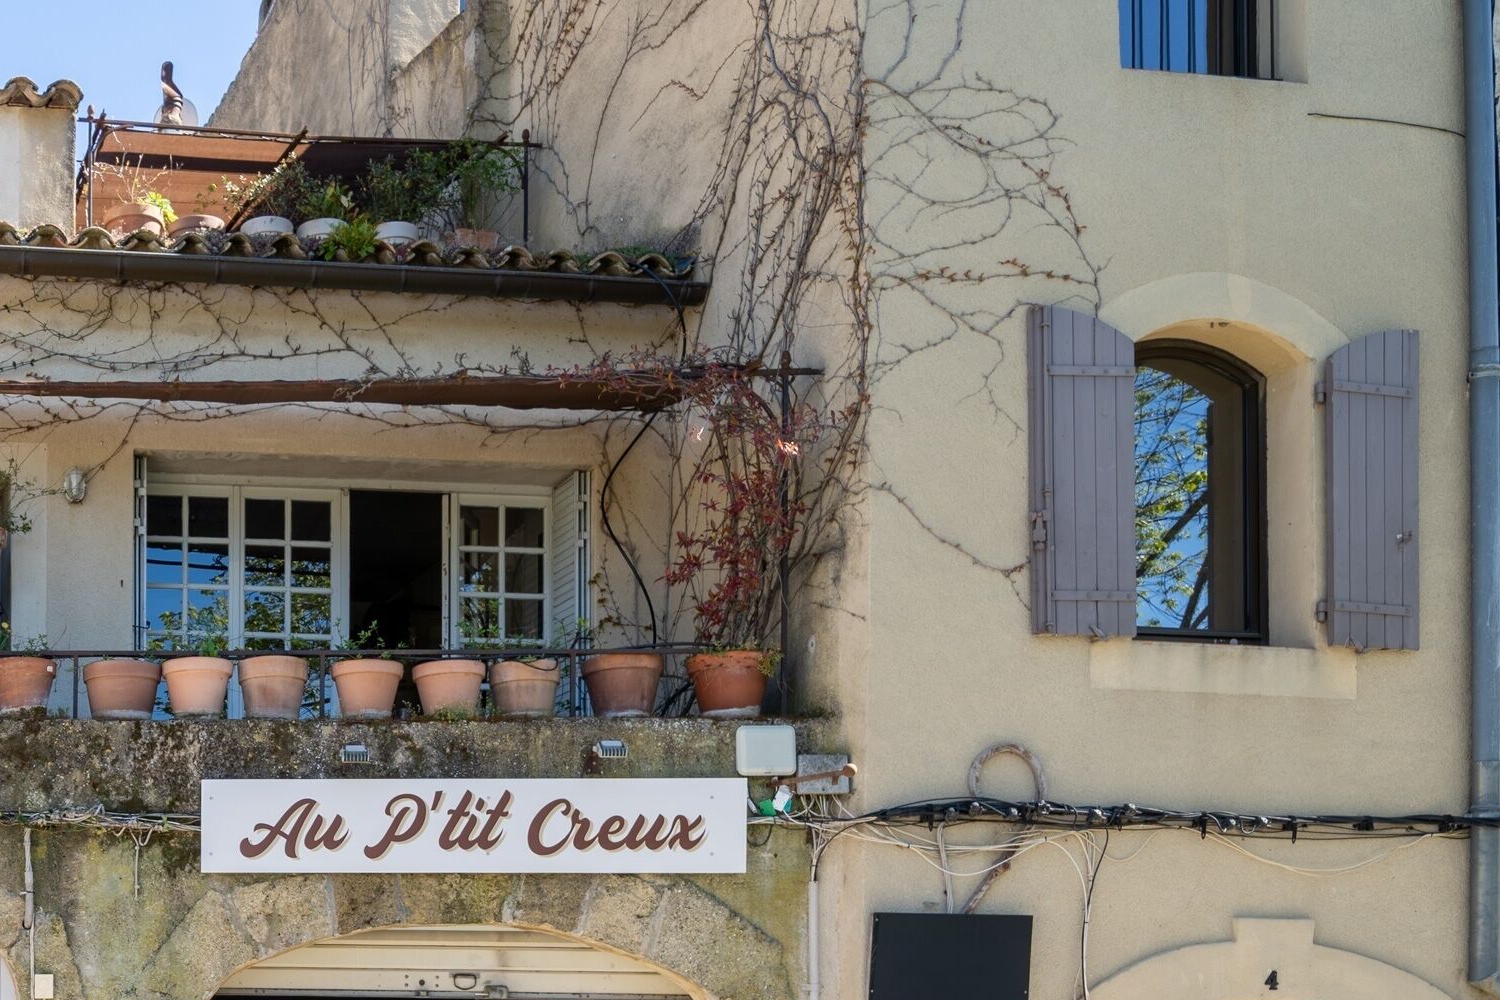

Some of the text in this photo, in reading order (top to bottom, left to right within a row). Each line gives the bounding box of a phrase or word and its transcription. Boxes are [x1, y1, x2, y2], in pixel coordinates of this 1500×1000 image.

[238, 790, 709, 860] Au P'tit Creux
[1264, 970, 1279, 990] 4
